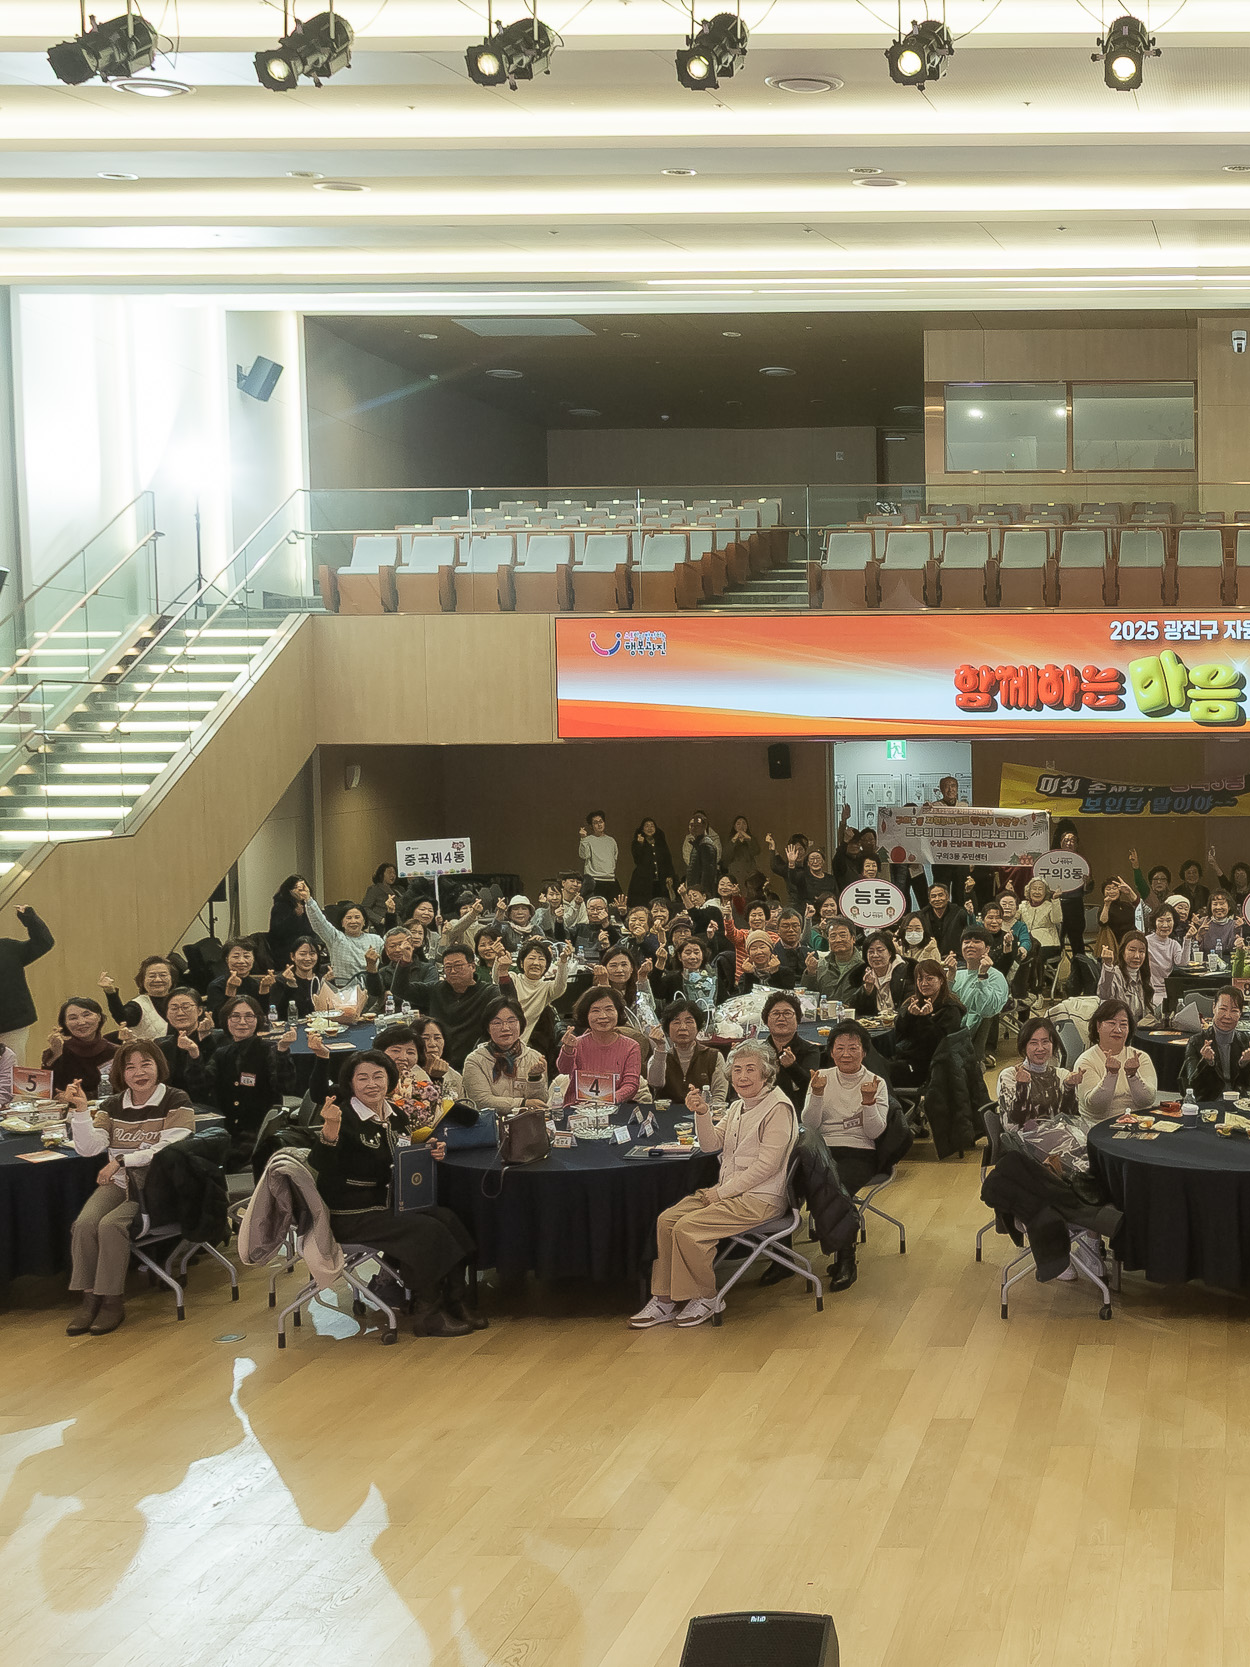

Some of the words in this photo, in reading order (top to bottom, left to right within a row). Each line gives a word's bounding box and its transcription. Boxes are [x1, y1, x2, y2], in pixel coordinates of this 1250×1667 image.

[1109, 620, 1159, 641] 2025
[1163, 620, 1219, 641] 광진구
[624, 641, 666, 656] 행복광진
[954, 663, 1124, 710] 함께하는
[1129, 650, 1244, 723] 마음
[1039, 776, 1080, 795] 미친
[1083, 796, 1145, 812] 보인단
[404, 850, 465, 867] 중곡제4동
[936, 852, 960, 861] 구의3동
[961, 852, 988, 861] 주민센터
[1038, 868, 1083, 880] 구의3동
[854, 887, 891, 905] 능동
[26, 1074, 37, 1092] 5
[589, 1078, 600, 1096] 4
